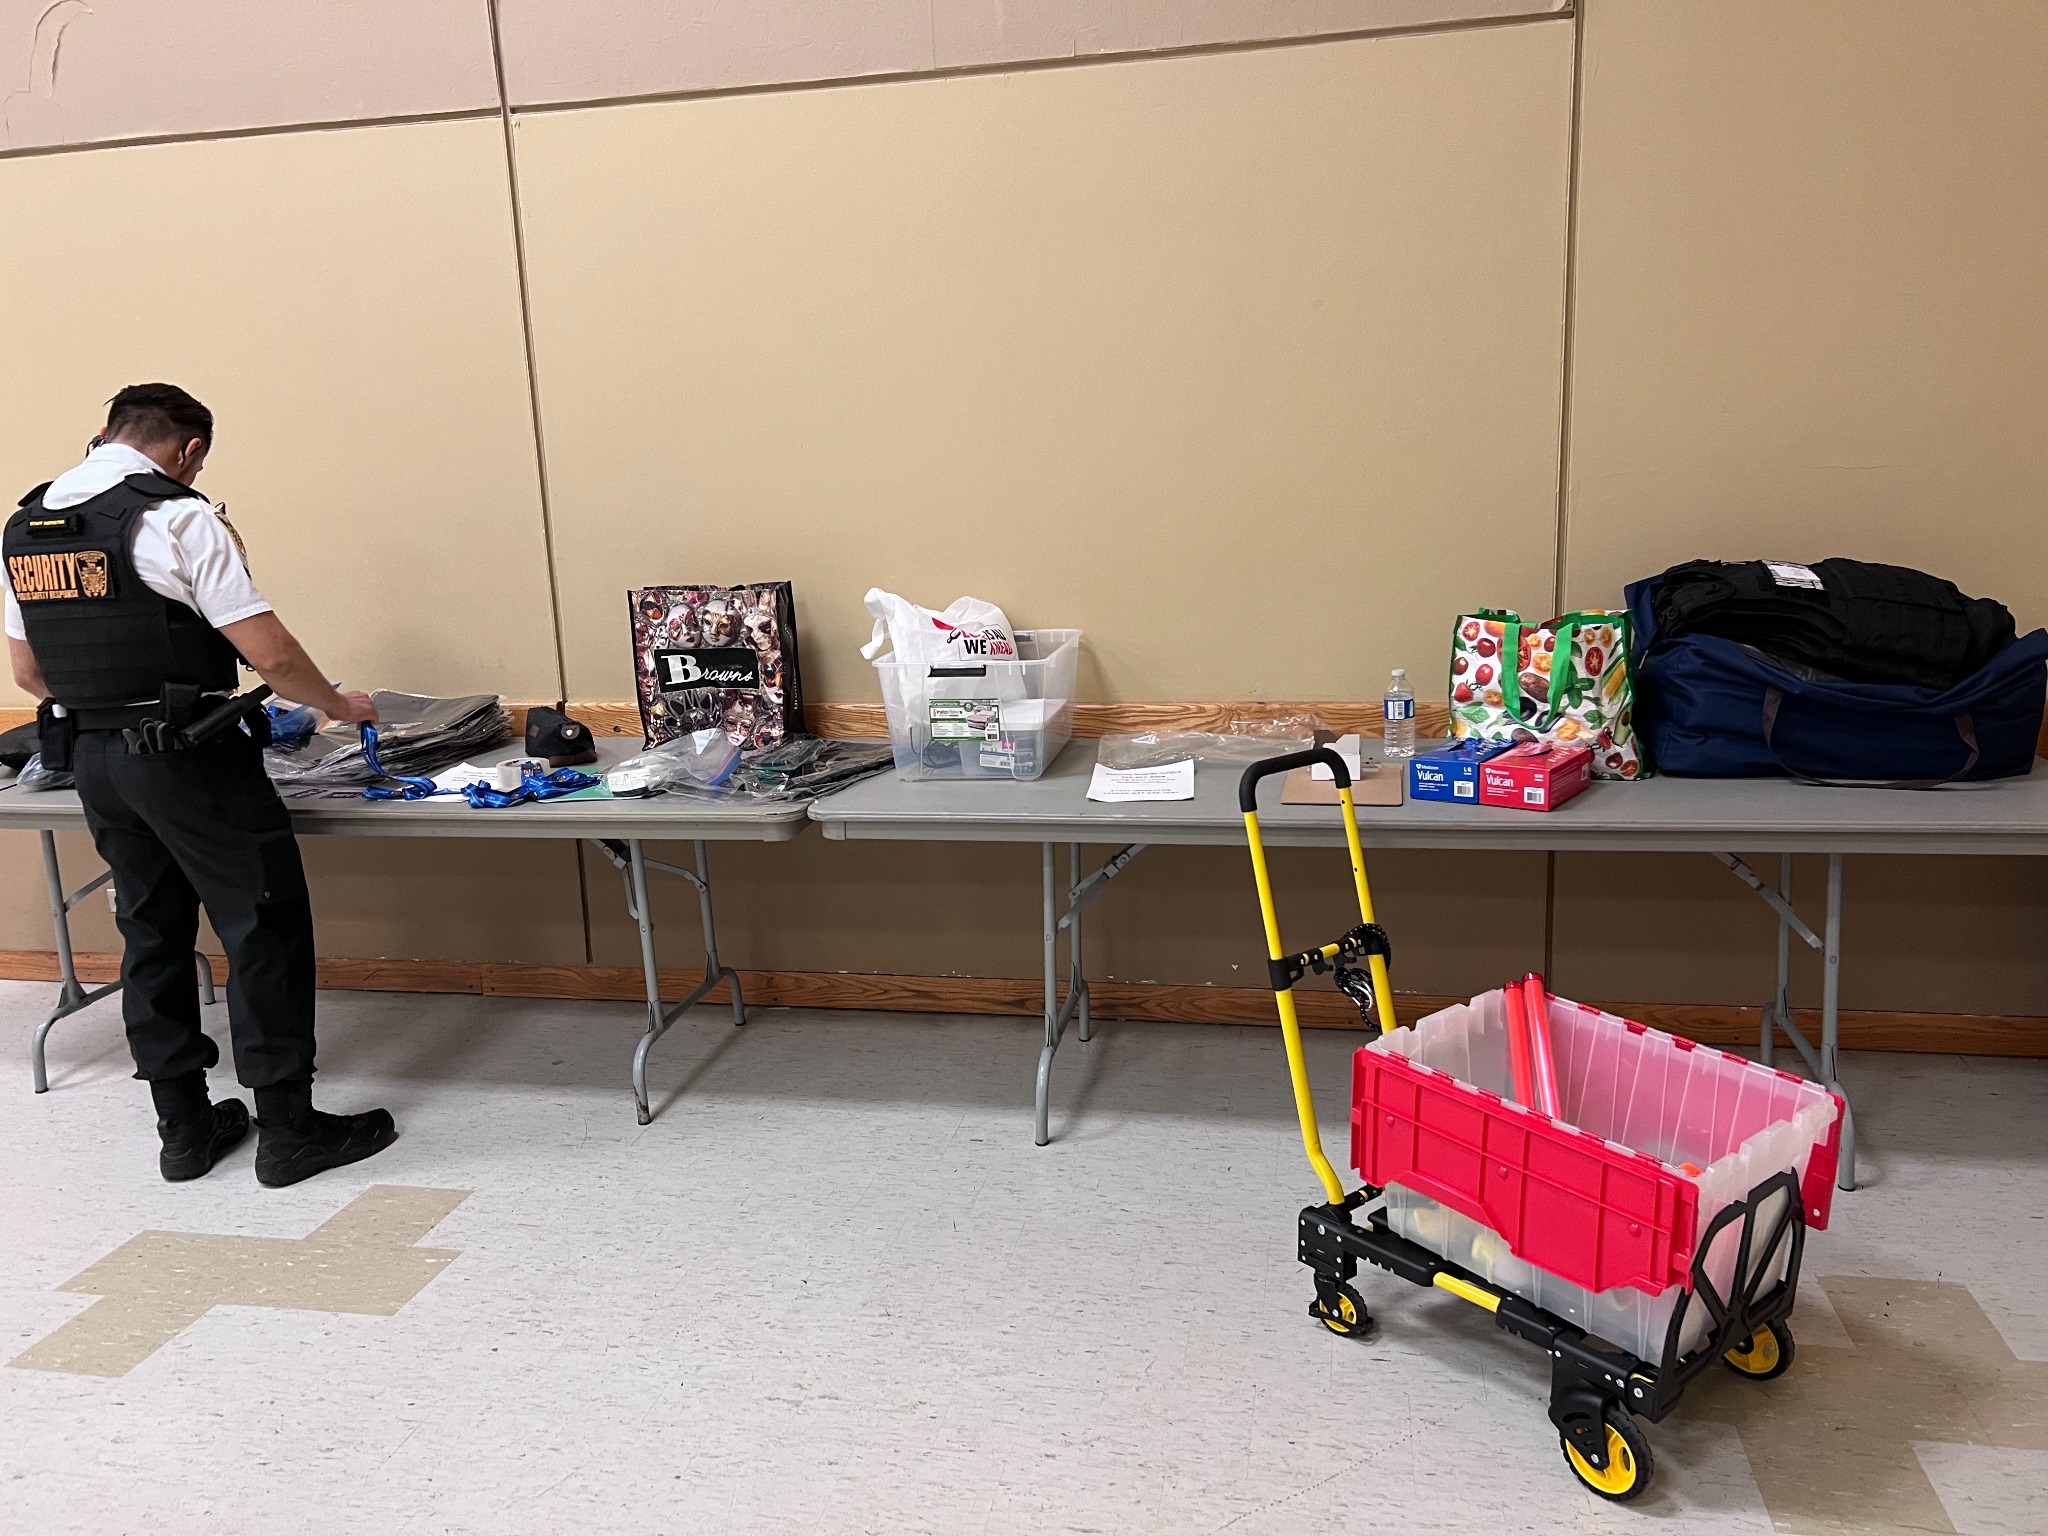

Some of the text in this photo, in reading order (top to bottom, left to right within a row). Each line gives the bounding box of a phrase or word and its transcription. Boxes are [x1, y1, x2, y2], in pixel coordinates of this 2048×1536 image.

[8, 552, 77, 593] SECURITY
[963, 639, 987, 655] WE
[660, 654, 754, 686] Browns
[1416, 769, 1444, 782] Vulcan
[1485, 774, 1514, 788] Vulcan
